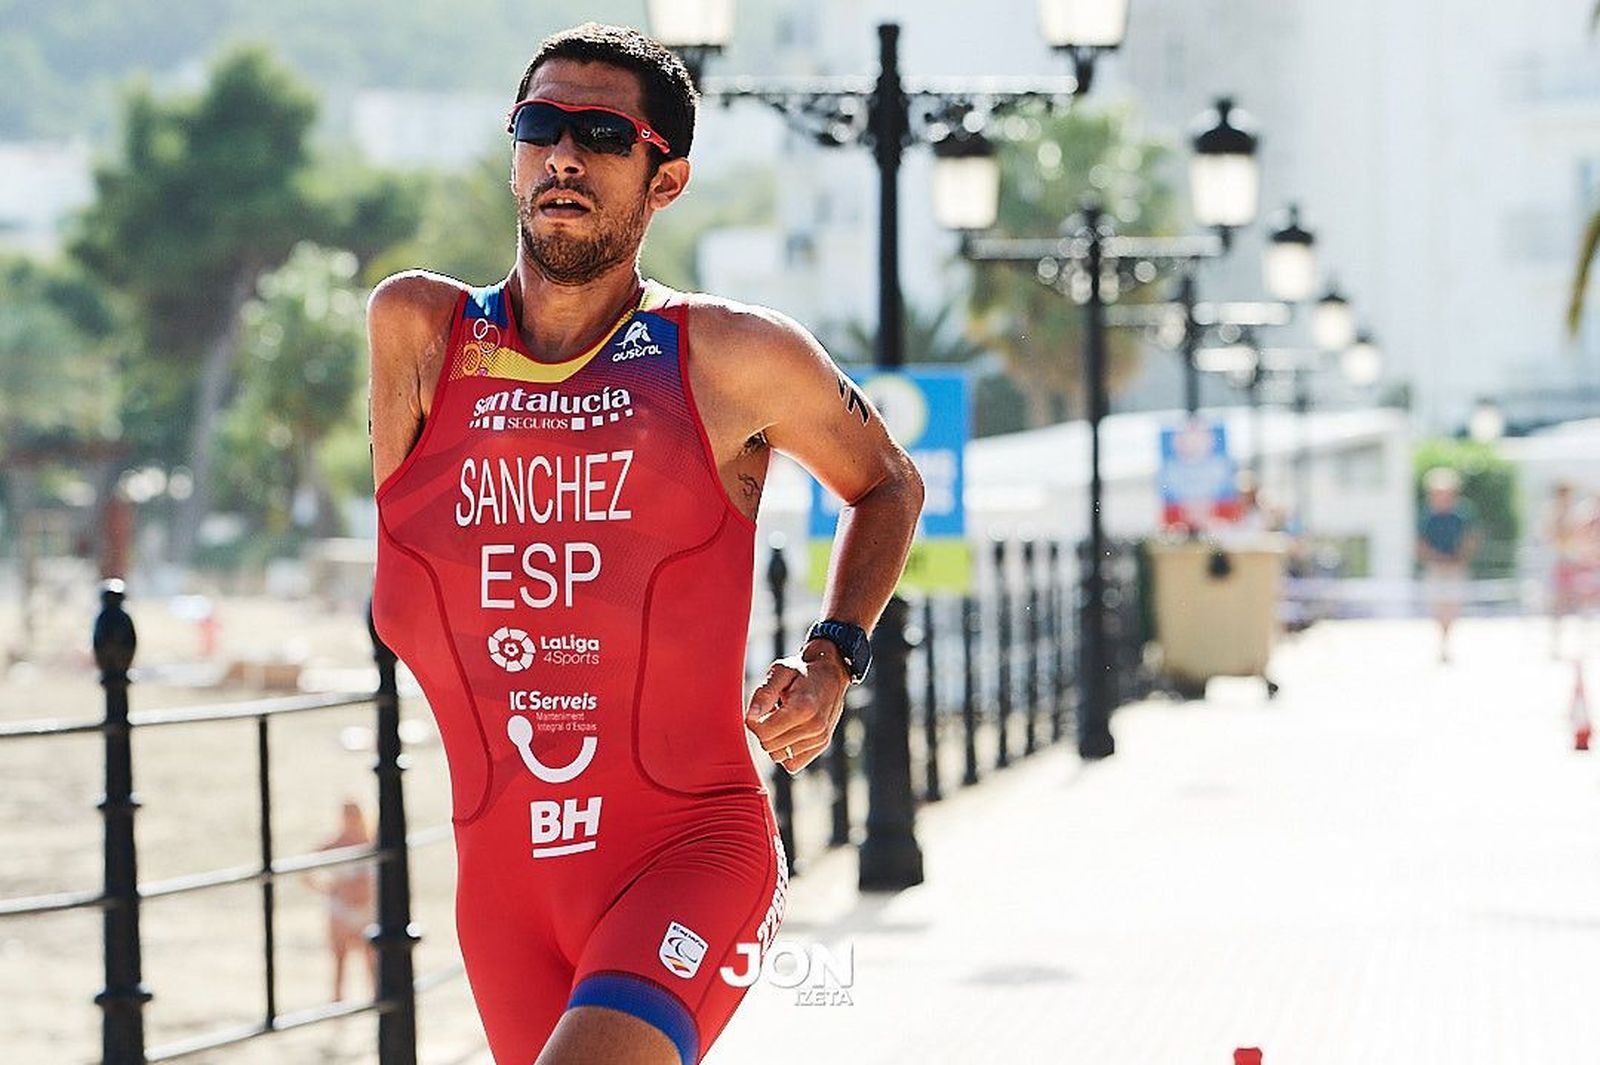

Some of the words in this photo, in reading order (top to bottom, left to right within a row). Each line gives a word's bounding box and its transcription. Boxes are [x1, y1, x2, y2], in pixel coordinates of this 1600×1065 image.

[612, 344, 663, 362] austral
[472, 386, 631, 417] santalucía
[507, 417, 569, 430] SEGUROS
[455, 450, 634, 526] SANCHEZ
[481, 542, 602, 608] ESP
[540, 634, 600, 653] LaLiga
[543, 651, 600, 665] 4Sports
[530, 797, 602, 844] BH
